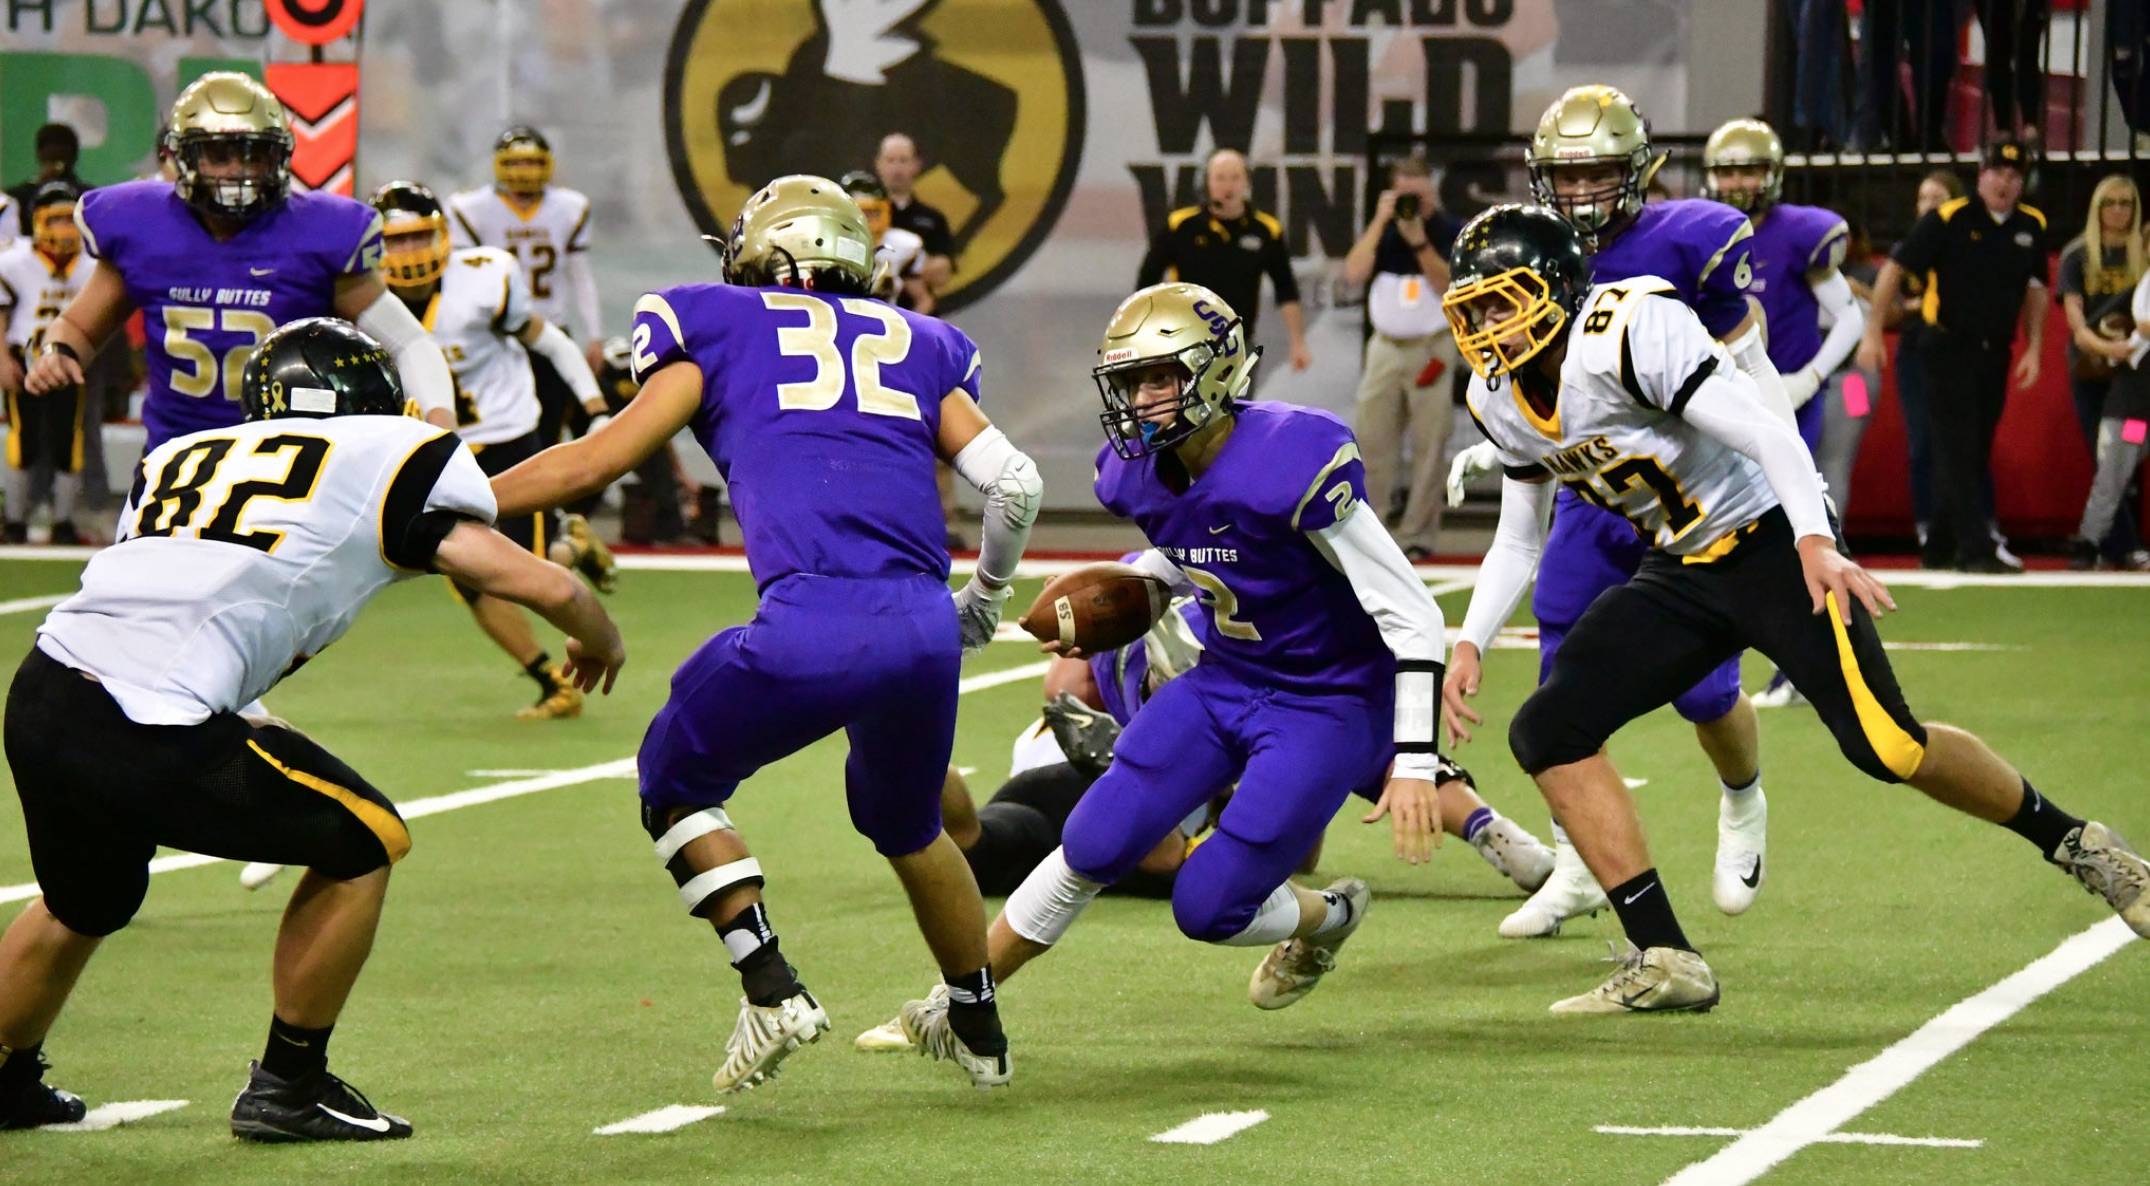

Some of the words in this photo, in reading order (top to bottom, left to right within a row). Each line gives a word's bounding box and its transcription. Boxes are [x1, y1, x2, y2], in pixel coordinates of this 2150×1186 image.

[86, 0, 272, 38] DAKO
[1128, 36, 1513, 154] WILD
[1733, 250, 1753, 290] 6
[168, 286, 212, 304] SULLY
[215, 287, 272, 307] BUTTES
[161, 304, 277, 402] 52
[759, 291, 922, 422] 32
[1542, 435, 1618, 476] HAWKS
[136, 433, 336, 555] 82
[1324, 480, 1357, 522] 2
[1189, 547, 1239, 564] BUTTES
[1181, 564, 1263, 642] 2
